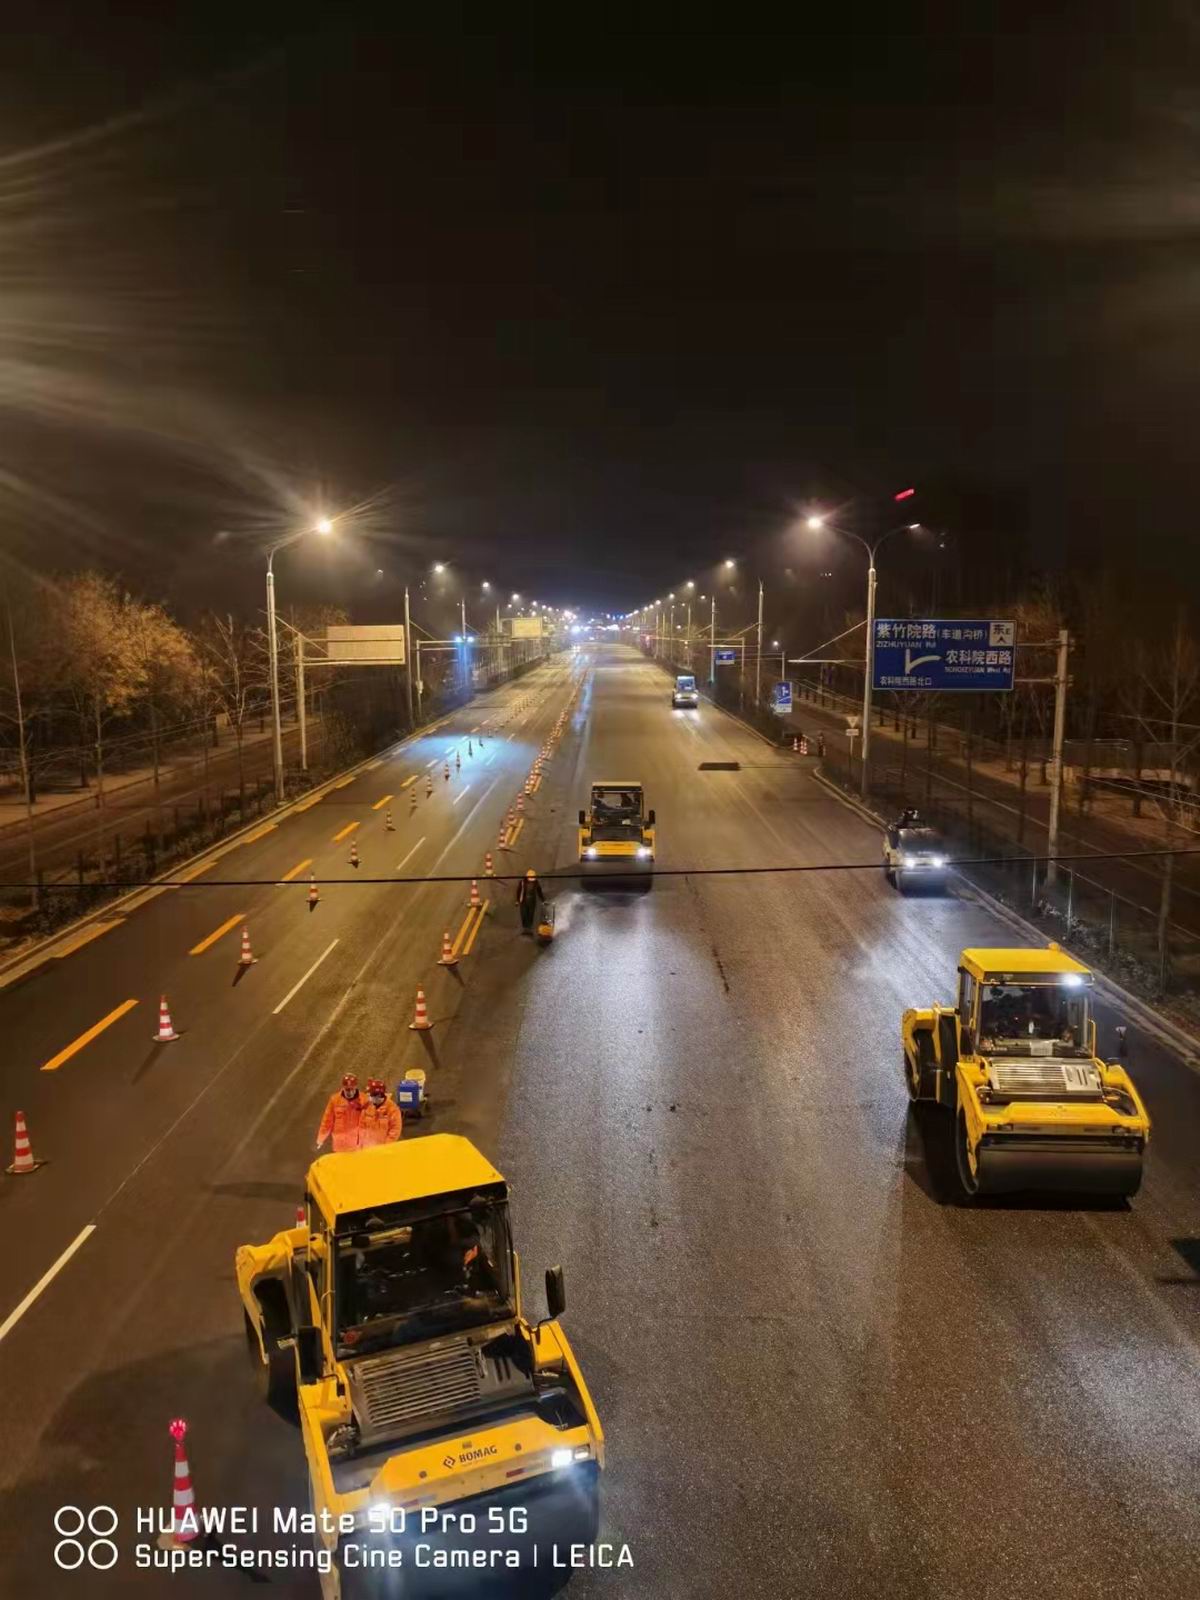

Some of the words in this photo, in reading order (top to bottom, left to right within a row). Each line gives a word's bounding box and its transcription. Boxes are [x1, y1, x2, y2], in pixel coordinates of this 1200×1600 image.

[877, 623, 936, 639] 紫竹院路
[945, 650, 1012, 665] 农科院西路
[459, 1444, 498, 1463] BOMAG
